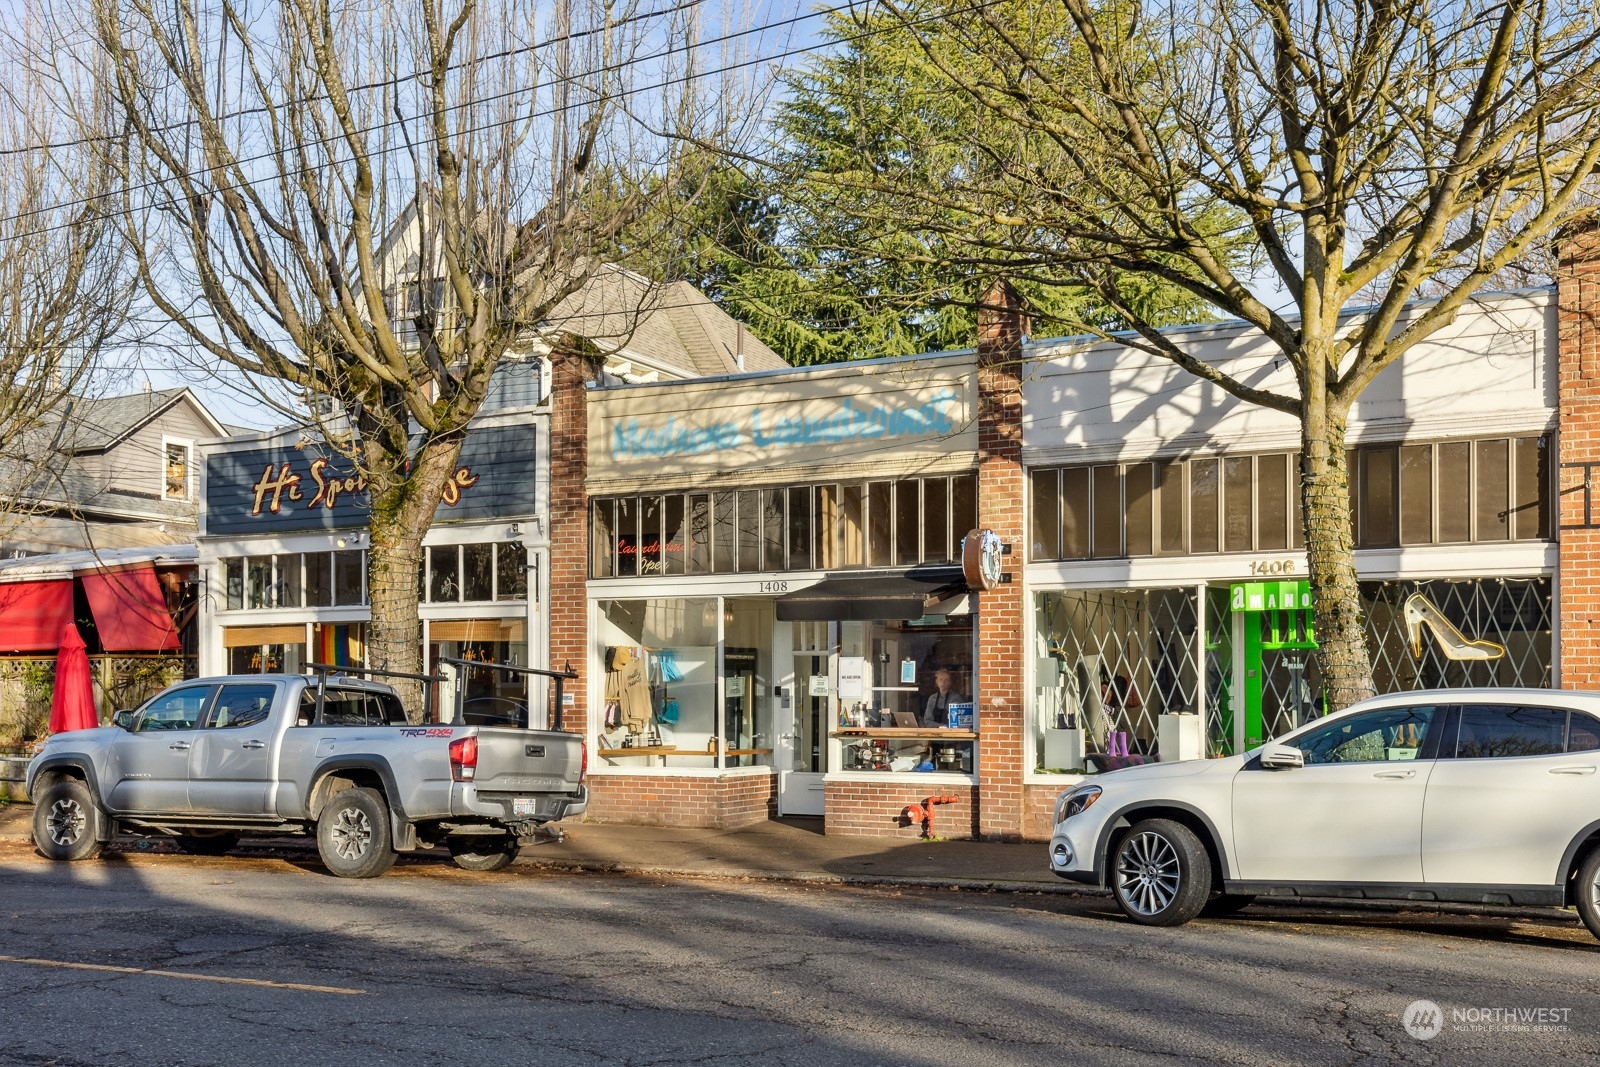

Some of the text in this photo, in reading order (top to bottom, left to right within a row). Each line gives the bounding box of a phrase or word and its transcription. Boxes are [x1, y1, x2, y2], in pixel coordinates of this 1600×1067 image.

[613, 389, 958, 458] Madrona Laundromat
[251, 463, 303, 515] Hi
[638, 558, 670, 575] Open
[1249, 560, 1296, 576] 1406
[759, 582, 787, 592] 1408
